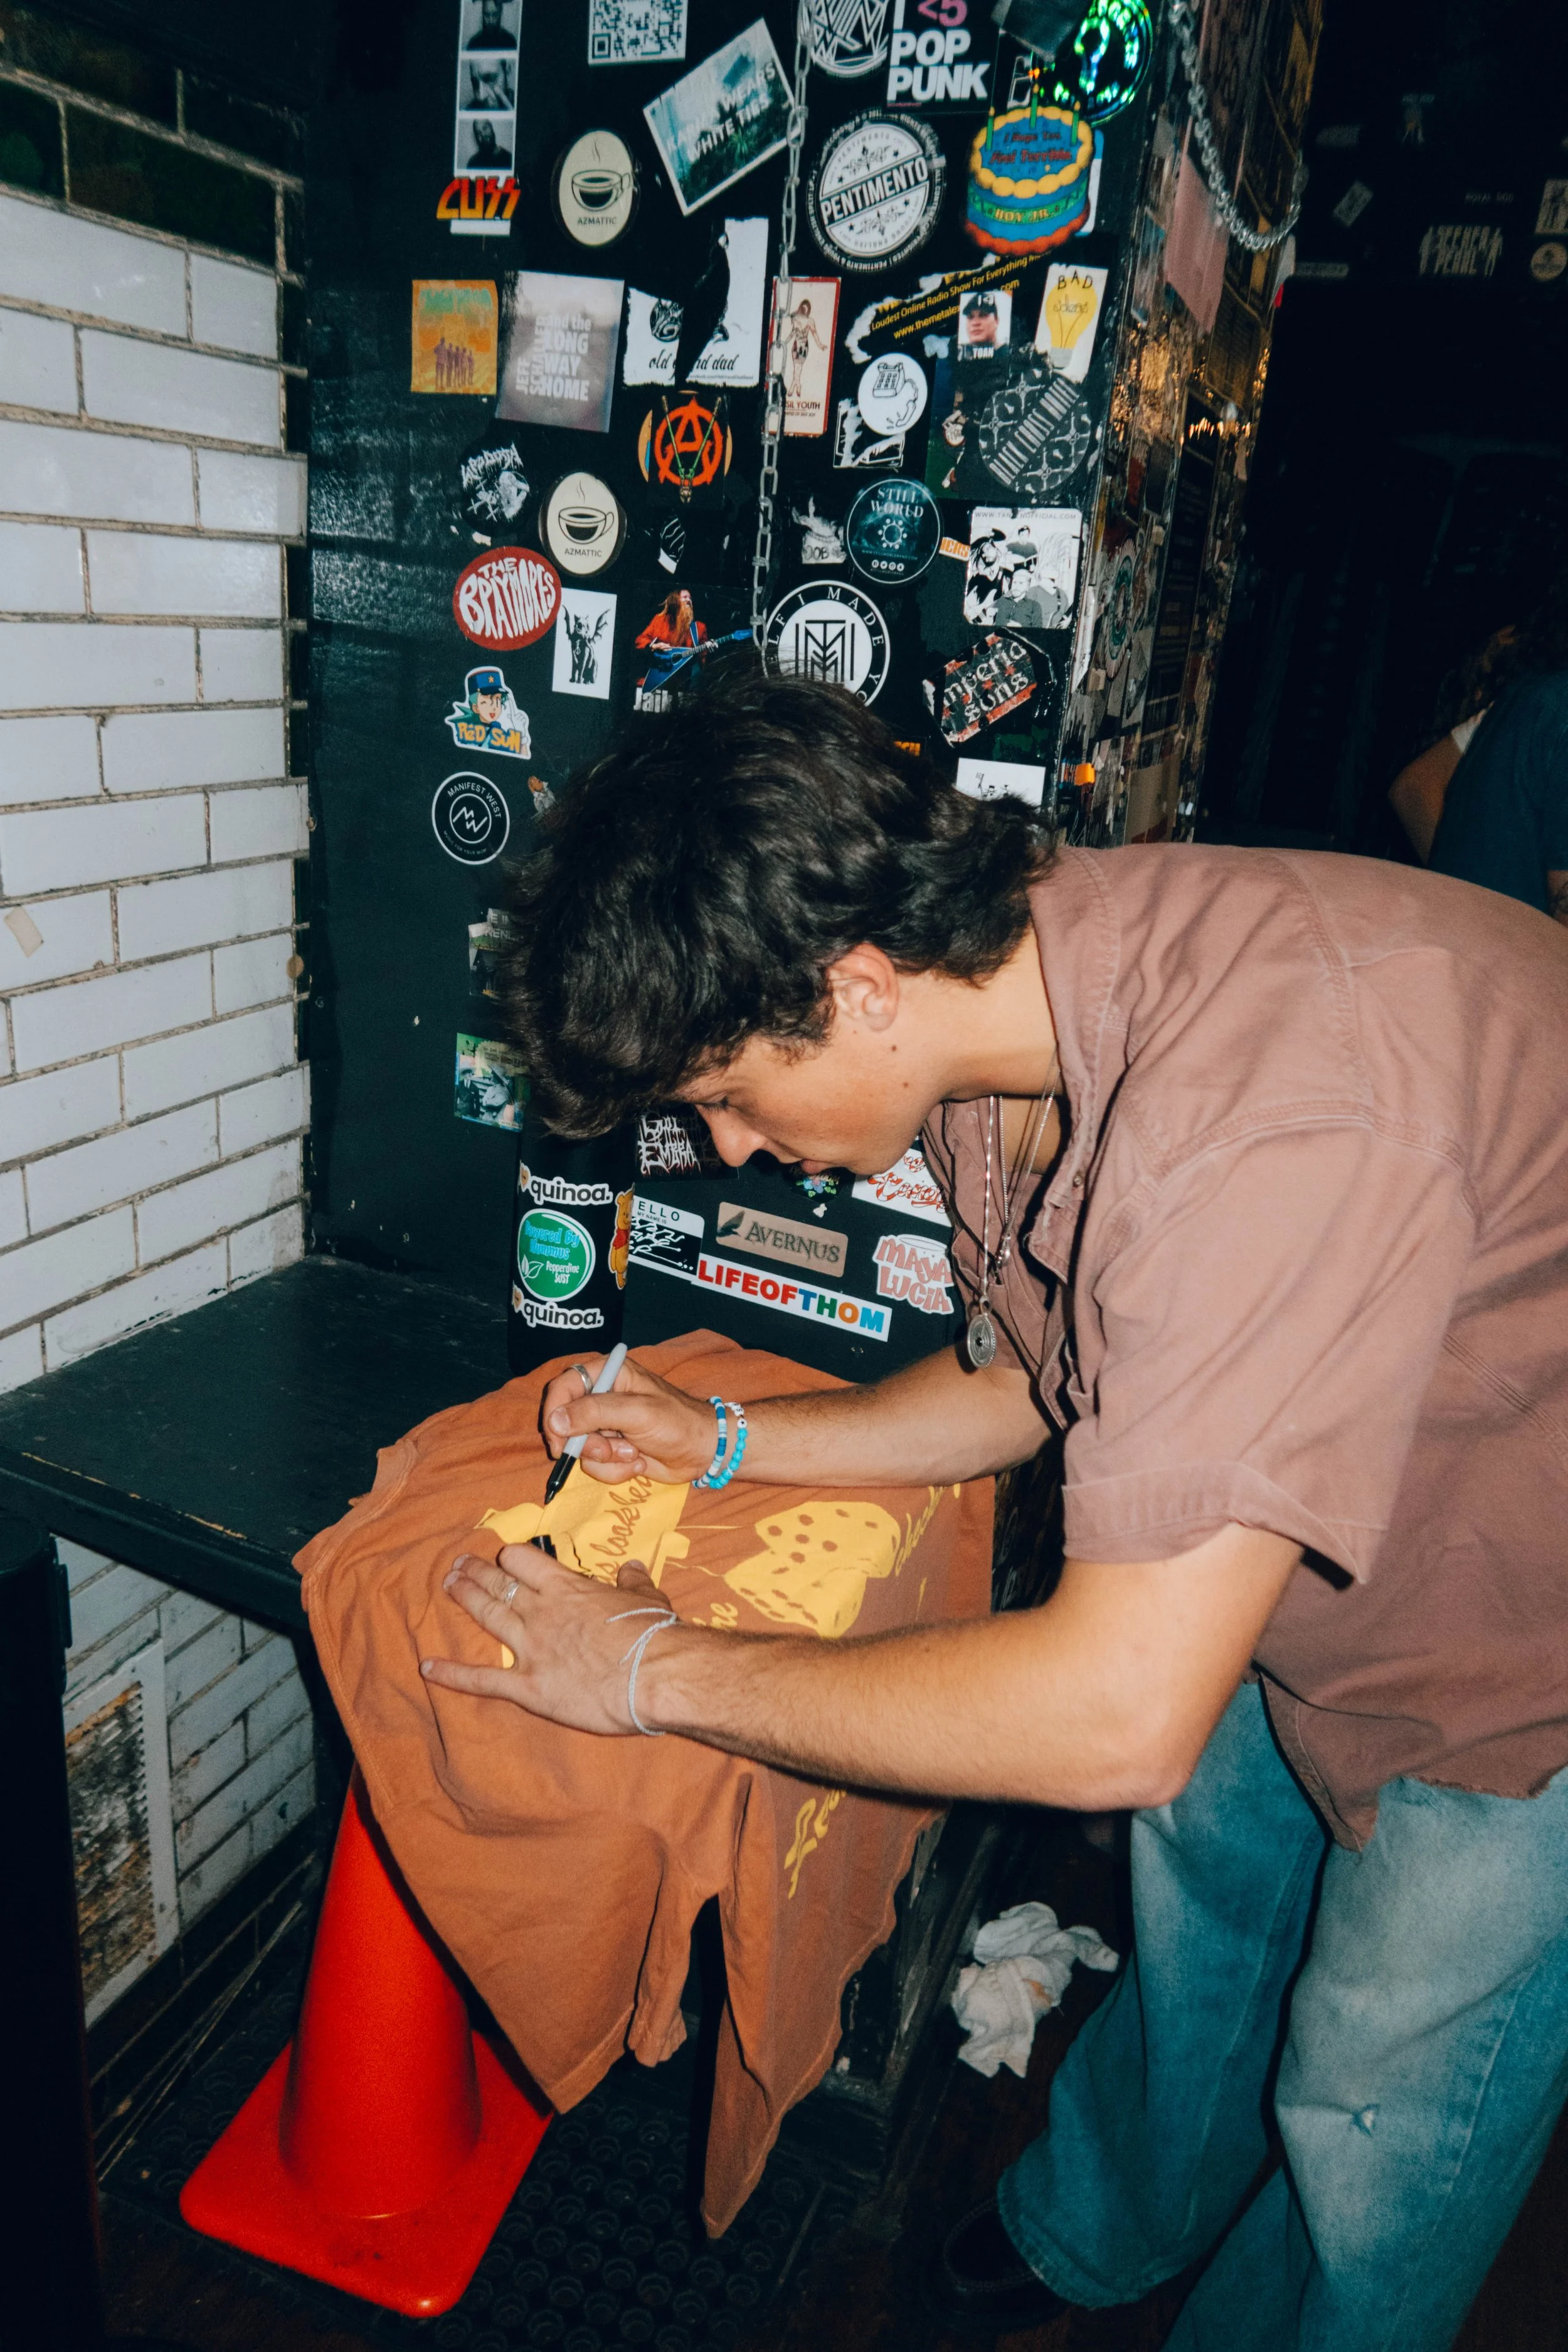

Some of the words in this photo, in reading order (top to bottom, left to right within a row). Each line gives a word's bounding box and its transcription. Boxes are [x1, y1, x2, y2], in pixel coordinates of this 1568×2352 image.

[890, 29, 971, 65] POP
[886, 63, 990, 102] PUNK
[687, 118, 735, 164] WHITE
[736, 93, 770, 127] TIES
[437, 177, 521, 220] CUSS
[820, 157, 929, 226] PENTIMENTO
[577, 216, 617, 226] AZMATTIC
[1057, 270, 1093, 290] BAD
[872, 310, 901, 331] Loudest
[901, 302, 926, 318] Online
[927, 290, 949, 307] Radio
[949, 281, 972, 297] Show
[972, 275, 985, 289] For
[985, 256, 1028, 281] Everything
[571, 314, 591, 331] the
[544, 329, 588, 354] LONG
[544, 352, 581, 378] WAY
[649, 349, 672, 369] old
[712, 354, 740, 371] dad
[516, 356, 531, 395] JEFF
[544, 375, 590, 401] HOME
[796, 401, 820, 410] YOUTH
[989, 440, 1029, 485] BLACK
[1014, 408, 1054, 453] CROSS
[877, 487, 918, 504] STILL
[871, 500, 924, 518] WORLD
[564, 548, 603, 558] AZMATTIC
[479, 557, 517, 579] THE
[797, 593, 806, 607] I
[827, 586, 884, 647] MADE
[964, 672, 1029, 724] sons
[447, 782, 486, 797] MANIFEST
[486, 792, 501, 818] WEST
[531, 1180, 611, 1204] quinoa.
[638, 1200, 681, 1222] ELLO
[645, 1213, 660, 1222] NAME
[524, 1220, 561, 1244] Powered
[564, 1229, 581, 1248] By
[744, 1221, 840, 1264] AVERNUS
[529, 1238, 570, 1260] Hummus
[545, 1261, 580, 1274] Pepperdine
[698, 1260, 885, 1333] LIFEOFTHOM
[524, 1303, 601, 1327] quinoa.
